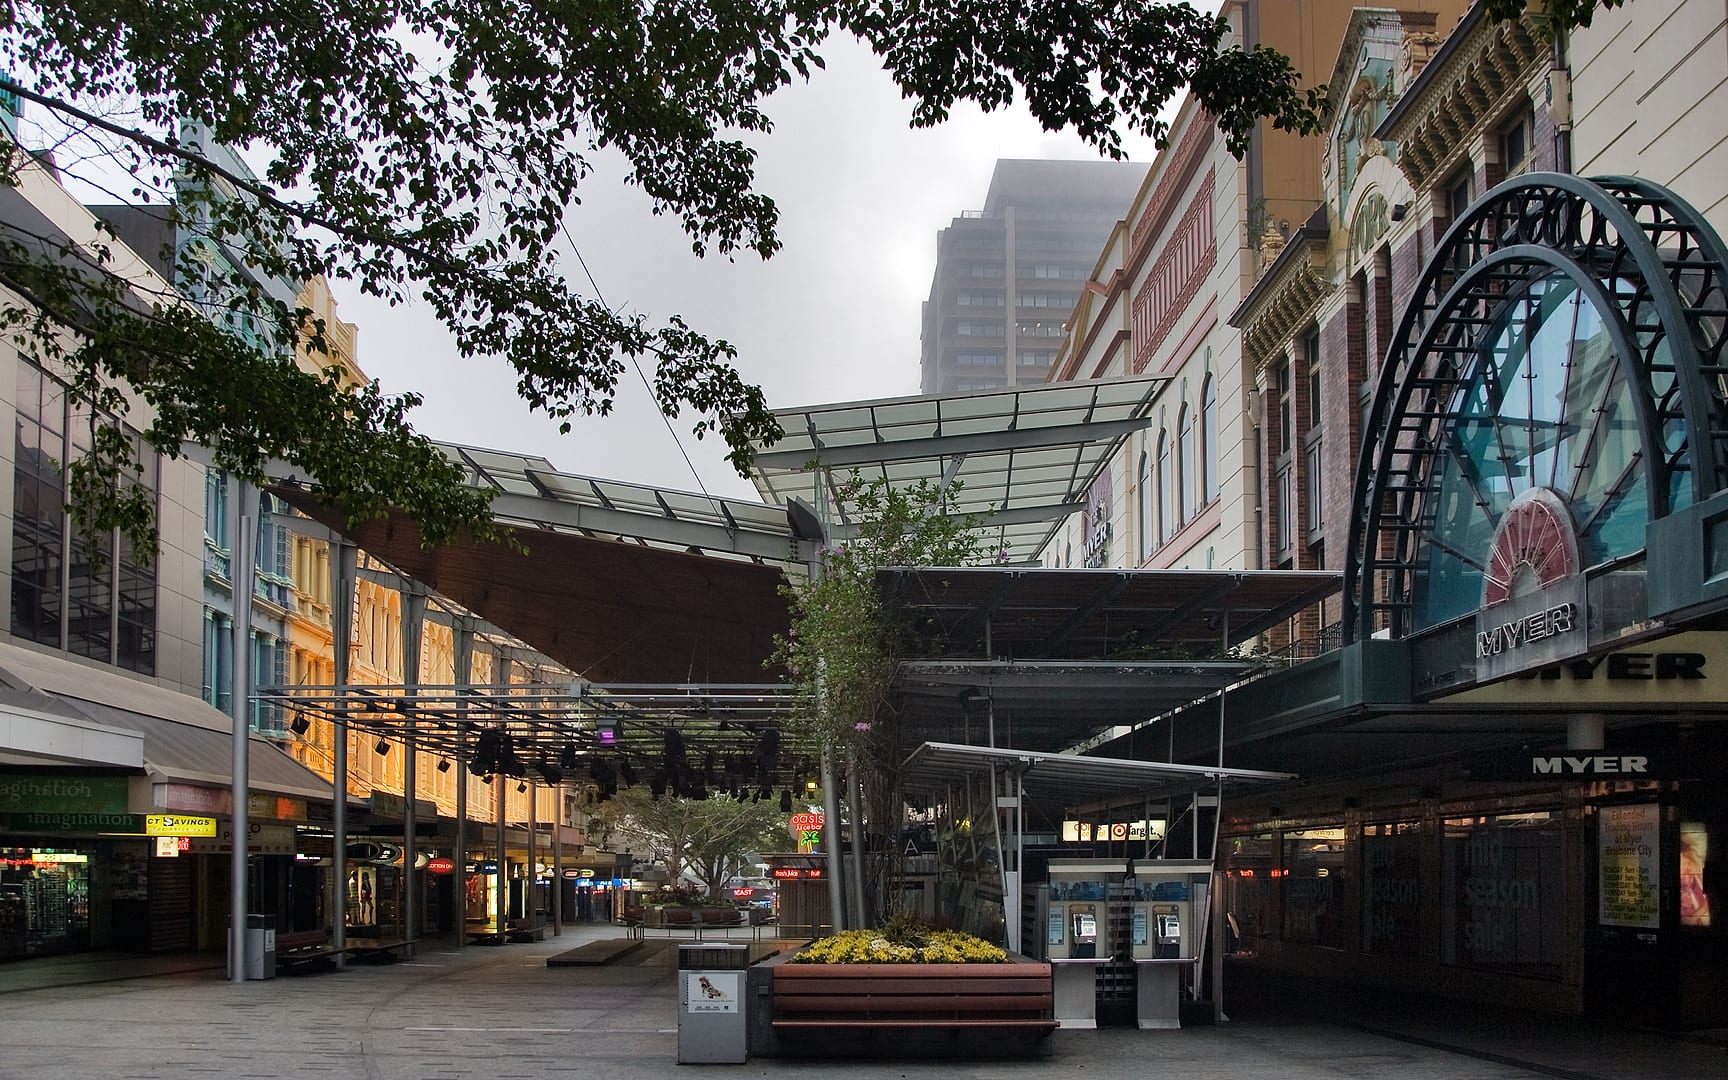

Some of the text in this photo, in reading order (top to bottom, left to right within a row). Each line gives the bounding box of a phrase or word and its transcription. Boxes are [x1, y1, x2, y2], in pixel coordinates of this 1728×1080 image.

[1475, 602, 1574, 658] MYER
[1531, 756, 1648, 774] MYER
[792, 815, 825, 824] oasis
